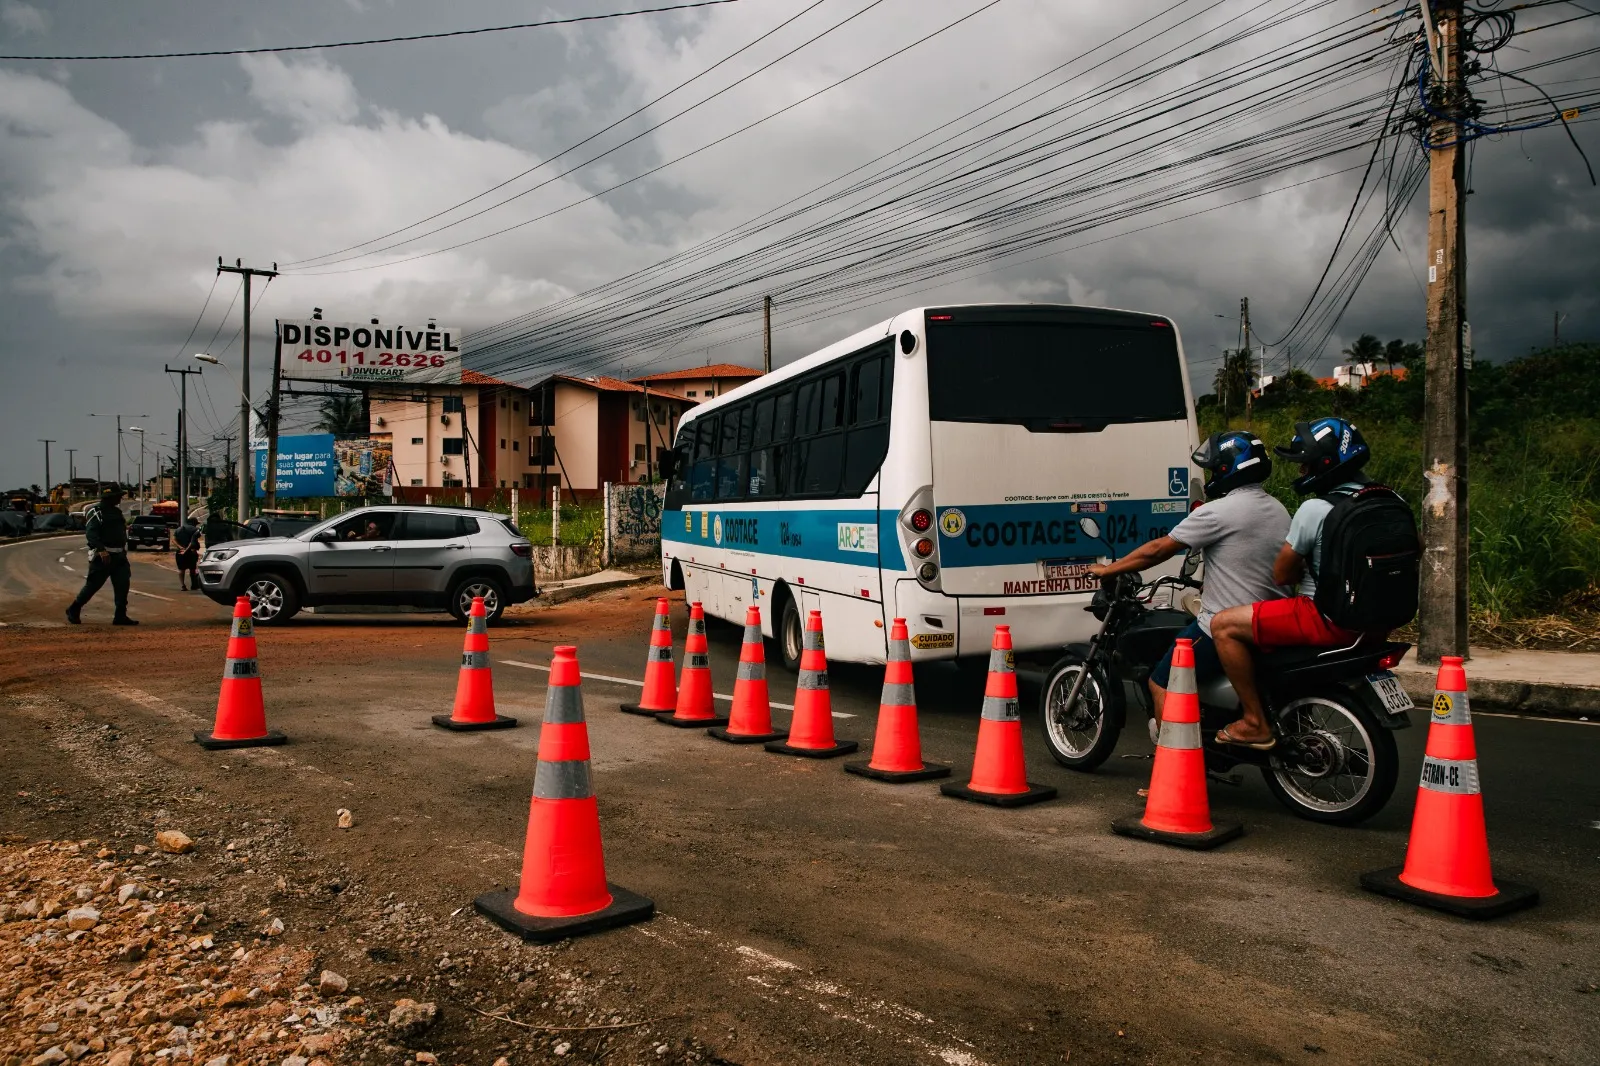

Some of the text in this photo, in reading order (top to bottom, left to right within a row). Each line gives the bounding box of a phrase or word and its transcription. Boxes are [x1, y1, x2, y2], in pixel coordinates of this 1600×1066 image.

[283, 324, 459, 352] DISPONÍVEL
[297, 349, 446, 368] 4011.2626
[353, 367, 405, 376] DIVULCART
[294, 452, 313, 461] lugar
[295, 460, 327, 468] compras
[294, 468, 324, 476] Vizinho.
[1035, 494, 1057, 502] Sempre
[1152, 502, 1176, 512] ARCE
[725, 518, 759, 545] COOTACE
[966, 519, 1077, 548] COOTACE
[1106, 513, 1139, 544] 024
[839, 526, 865, 549] ARCE
[1003, 578, 1071, 595] MANTENHA
[919, 634, 953, 642] CUIDADO
[1378, 678, 1398, 695] HXP
